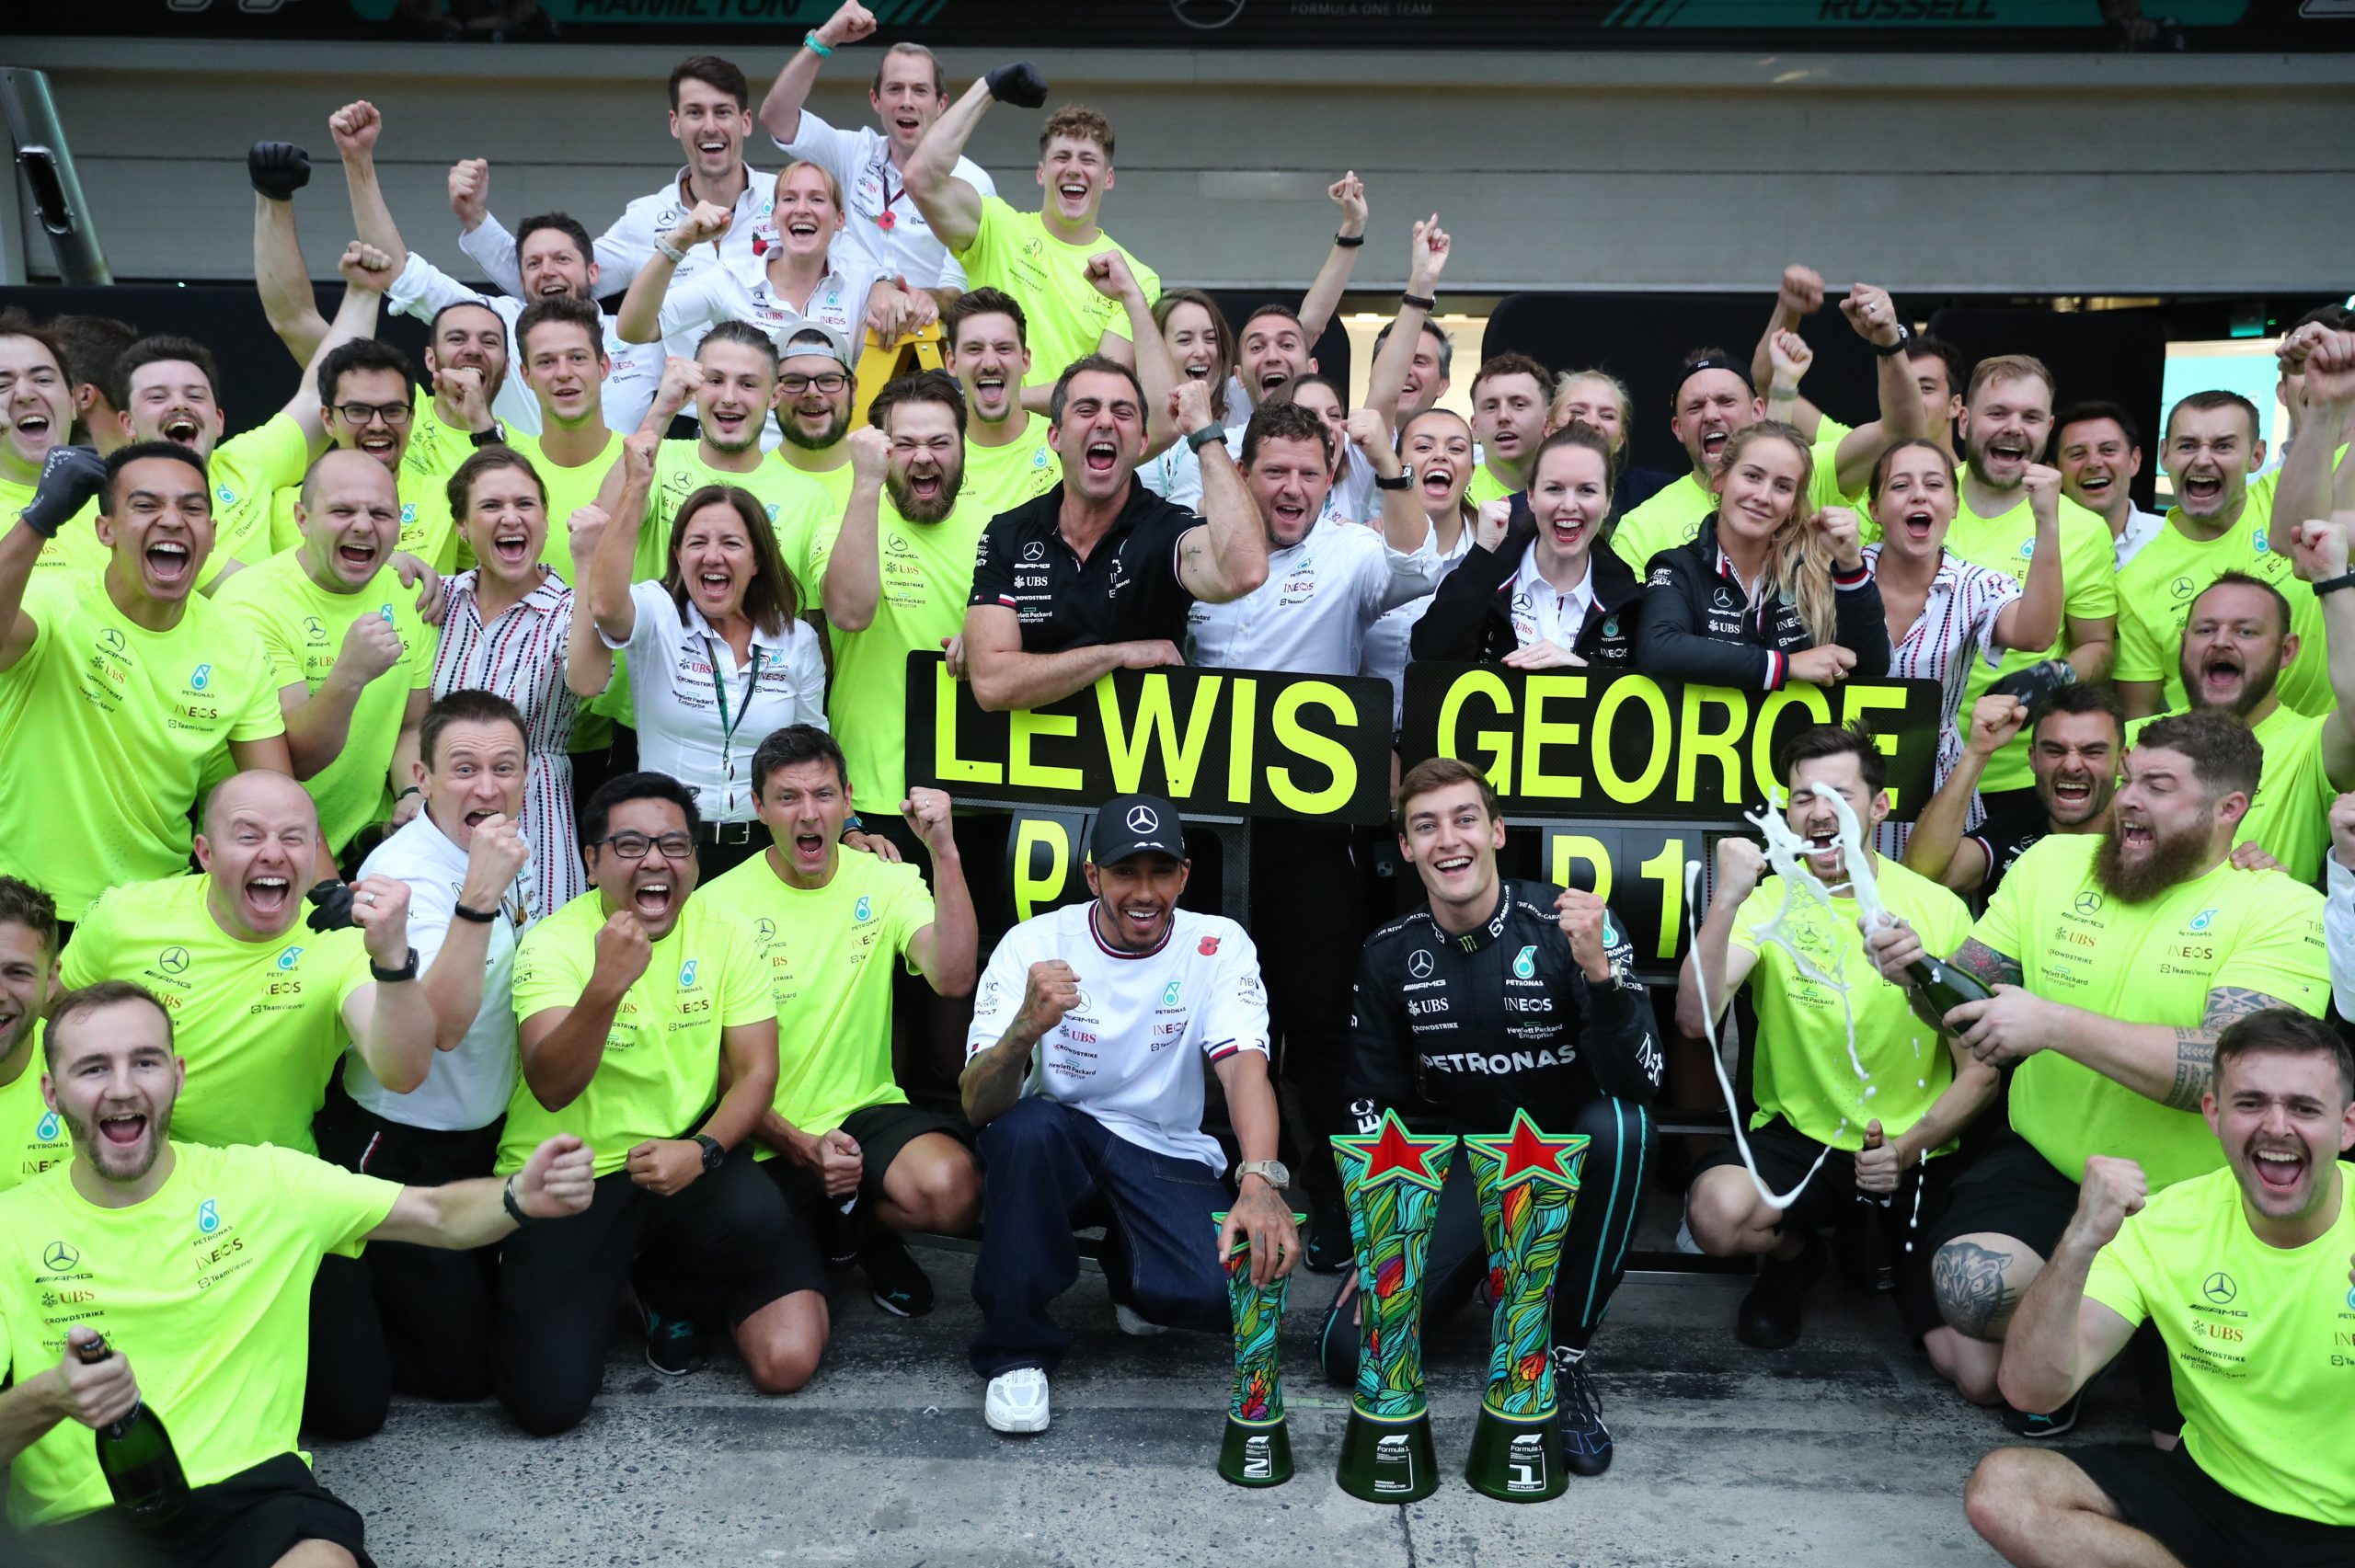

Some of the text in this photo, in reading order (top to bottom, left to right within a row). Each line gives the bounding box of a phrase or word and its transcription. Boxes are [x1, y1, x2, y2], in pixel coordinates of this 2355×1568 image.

[1291, 3, 1432, 15] FORMULA ONE TEAM
[1817, 0, 1995, 19] RUSSELL
[820, 316, 845, 325] INEOS
[900, 565, 919, 575] UBS
[1027, 577, 1048, 587] UBS
[1283, 582, 1315, 593] INEOS
[1515, 623, 1533, 635] UBS
[1719, 623, 1740, 634] UBS
[105, 665, 125, 684] UBS
[692, 663, 712, 674] UBS
[182, 690, 215, 698] PETRONAS
[174, 704, 217, 719] INEOS
[936, 660, 1358, 814] LEWIS
[2071, 918, 2104, 928] AMG
[2307, 920, 2325, 933] TIB
[2069, 933, 2096, 947] UBS
[2167, 944, 2212, 959] INEOS
[772, 956, 787, 967] BS
[159, 975, 191, 989] AMG
[1418, 979, 1446, 989] AMG
[1506, 979, 1544, 988] PETRONAS
[2045, 976, 2075, 989] Enterprise
[2061, 972, 2088, 986] Packard
[676, 986, 703, 994] ETRONAS
[1421, 998, 1449, 1013] UBS
[1504, 997, 1553, 1012] INEOS
[1809, 996, 1834, 1005] Packard
[263, 1003, 305, 1012] TeamViewer
[1412, 1022, 1459, 1034] CROWDSTRIKE
[1508, 1024, 1563, 1035] Hewlett Packard
[1072, 1031, 1097, 1044] UBS
[1520, 1032, 1553, 1041] Enterprise
[1055, 1043, 1097, 1059] CROWDSTRIKE
[1420, 1045, 1576, 1074] PETRONAS
[1049, 1061, 1097, 1075] Hewlett Packard
[1055, 1068, 1086, 1081] Enterprise
[28, 1142, 69, 1150] PETRONAS
[193, 1225, 234, 1246] PETRONAS
[195, 1238, 244, 1271] INEOS
[211, 1257, 253, 1283] TeamViewer
[55, 1273, 93, 1281] AMG
[59, 1292, 94, 1304] UBS
[45, 1310, 105, 1324] CROWDSTRIKE
[2208, 1309, 2247, 1317] AMG
[2210, 1324, 2244, 1342] UBS
[42, 1338, 66, 1349] Hewle
[1244, 1458, 1269, 1473] 2
[1509, 1464, 1543, 1484] 1
